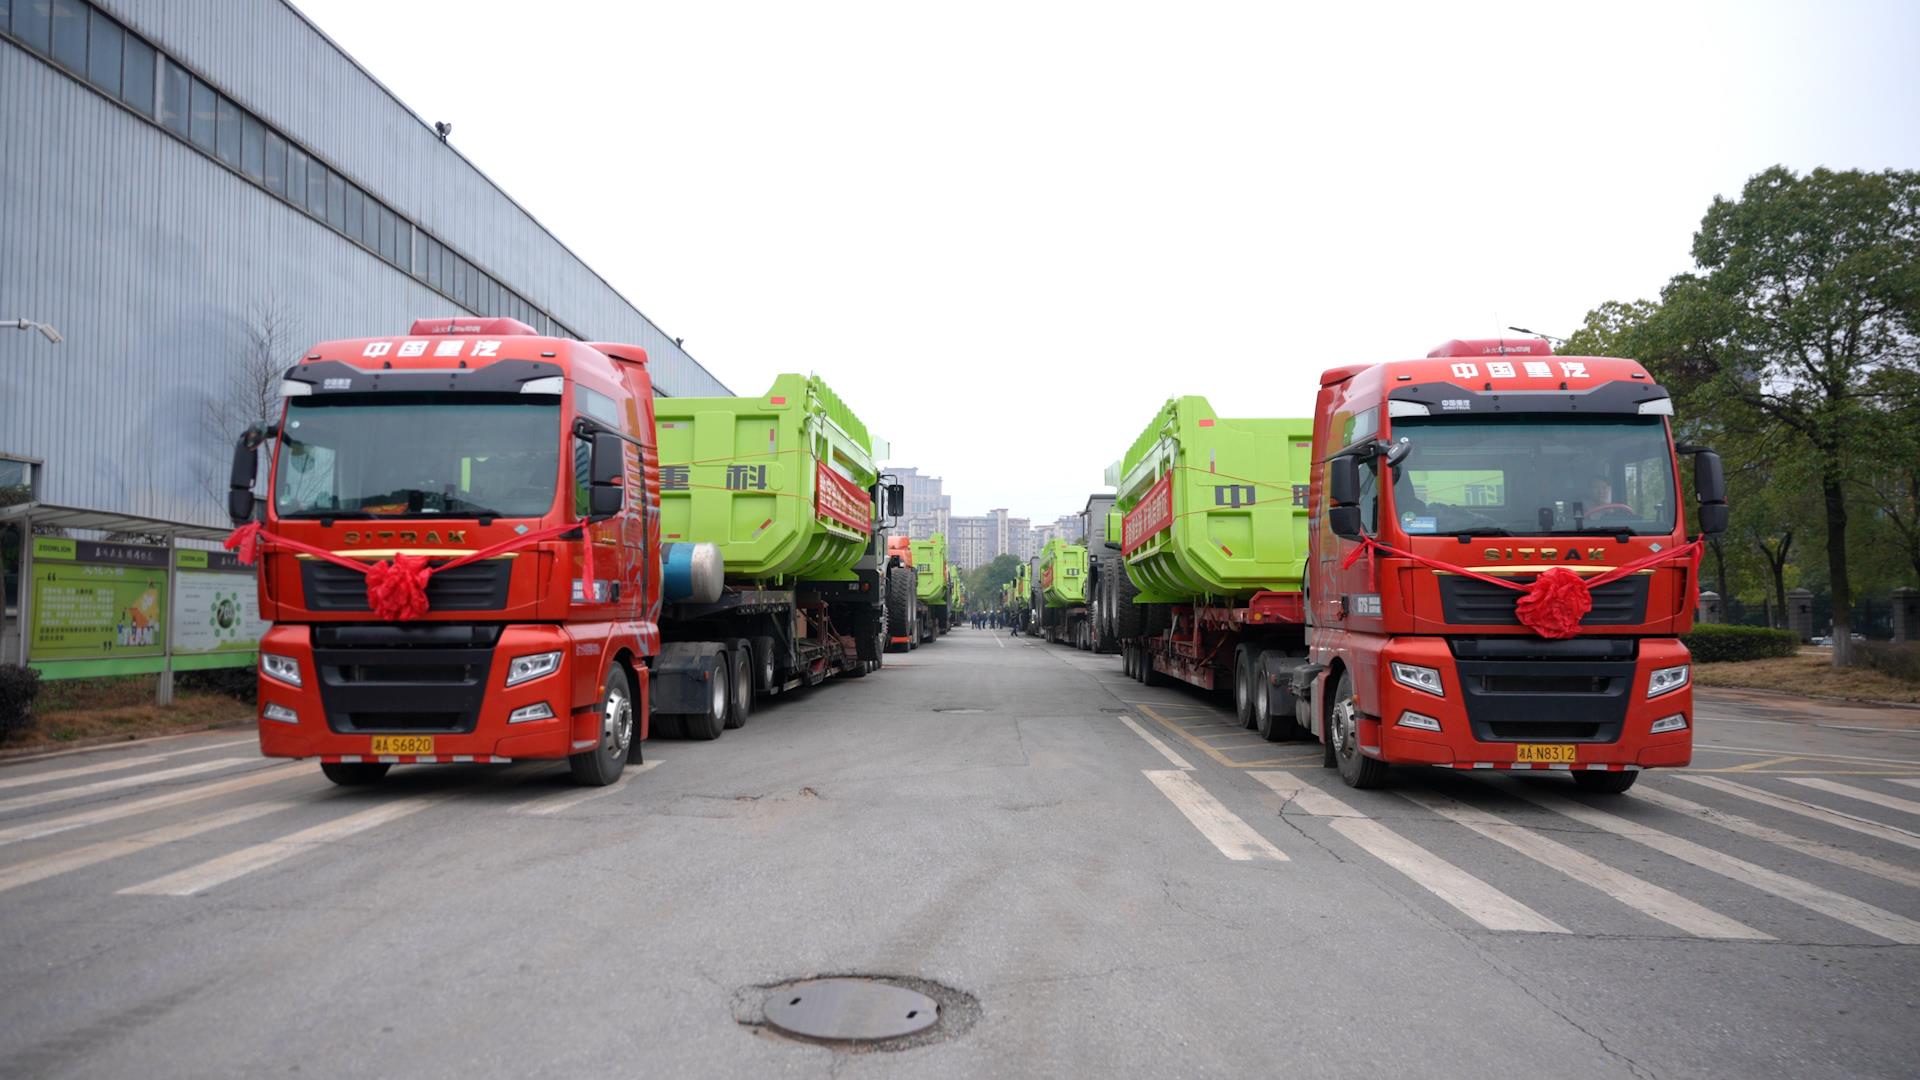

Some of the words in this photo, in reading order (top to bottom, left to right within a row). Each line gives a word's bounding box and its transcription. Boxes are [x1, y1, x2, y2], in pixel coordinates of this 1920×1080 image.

[362, 340, 502, 357] 中国重汽
[1450, 362, 1590, 379] 中国重汽
[343, 530, 466, 545] SITRAK
[1483, 547, 1606, 561] SITRAK
